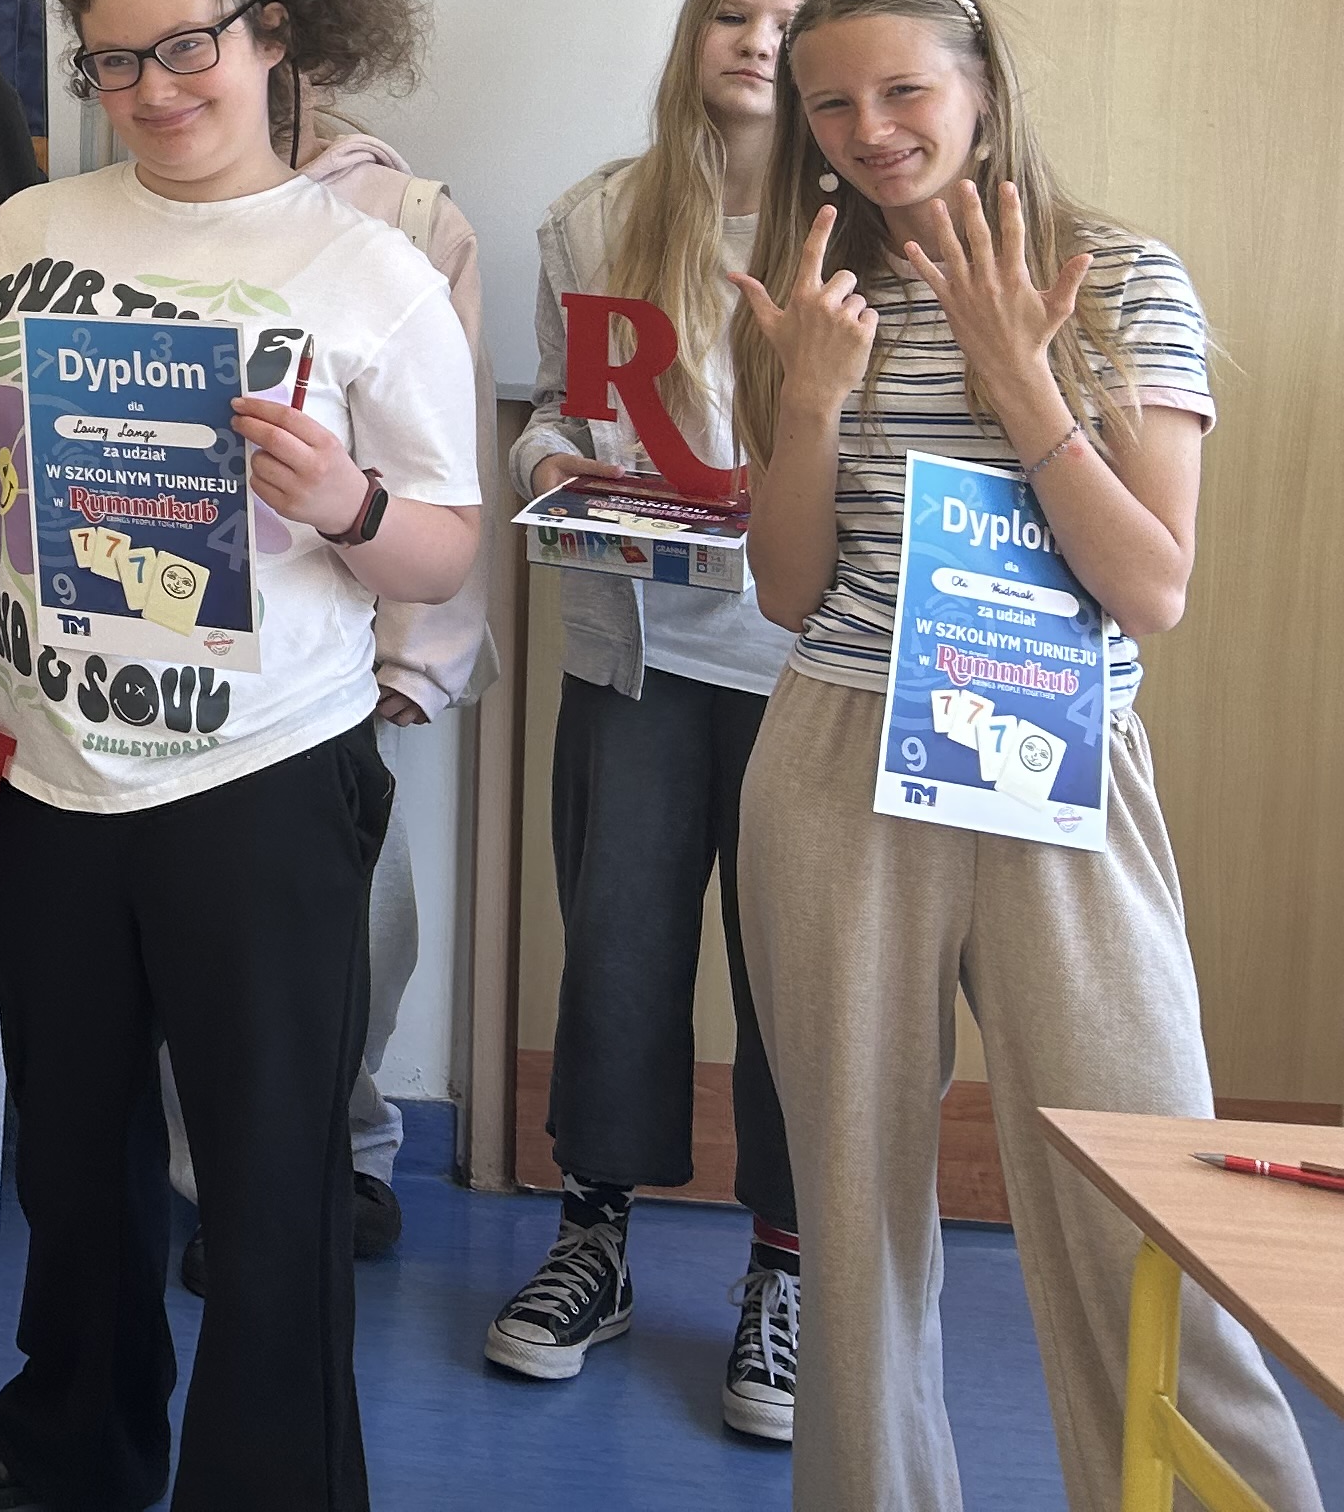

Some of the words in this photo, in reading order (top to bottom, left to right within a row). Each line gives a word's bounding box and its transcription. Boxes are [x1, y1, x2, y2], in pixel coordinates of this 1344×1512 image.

[57, 348, 207, 394] Dyplom
[127, 401, 144, 412] dla
[102, 447, 120, 459] za
[122, 446, 167, 462] udział
[46, 464, 62, 479] W
[65, 466, 151, 487] SZKOLNYM
[155, 472, 238, 494] TURNIEJU
[68, 485, 220, 526] Rummikub
[977, 606, 993, 619] za
[995, 607, 1037, 627] udział
[916, 617, 932, 635] W
[934, 621, 1022, 653] SZKOLNYM
[1023, 639, 1098, 667] TURNIEJU
[935, 643, 1081, 696] Rummikub
